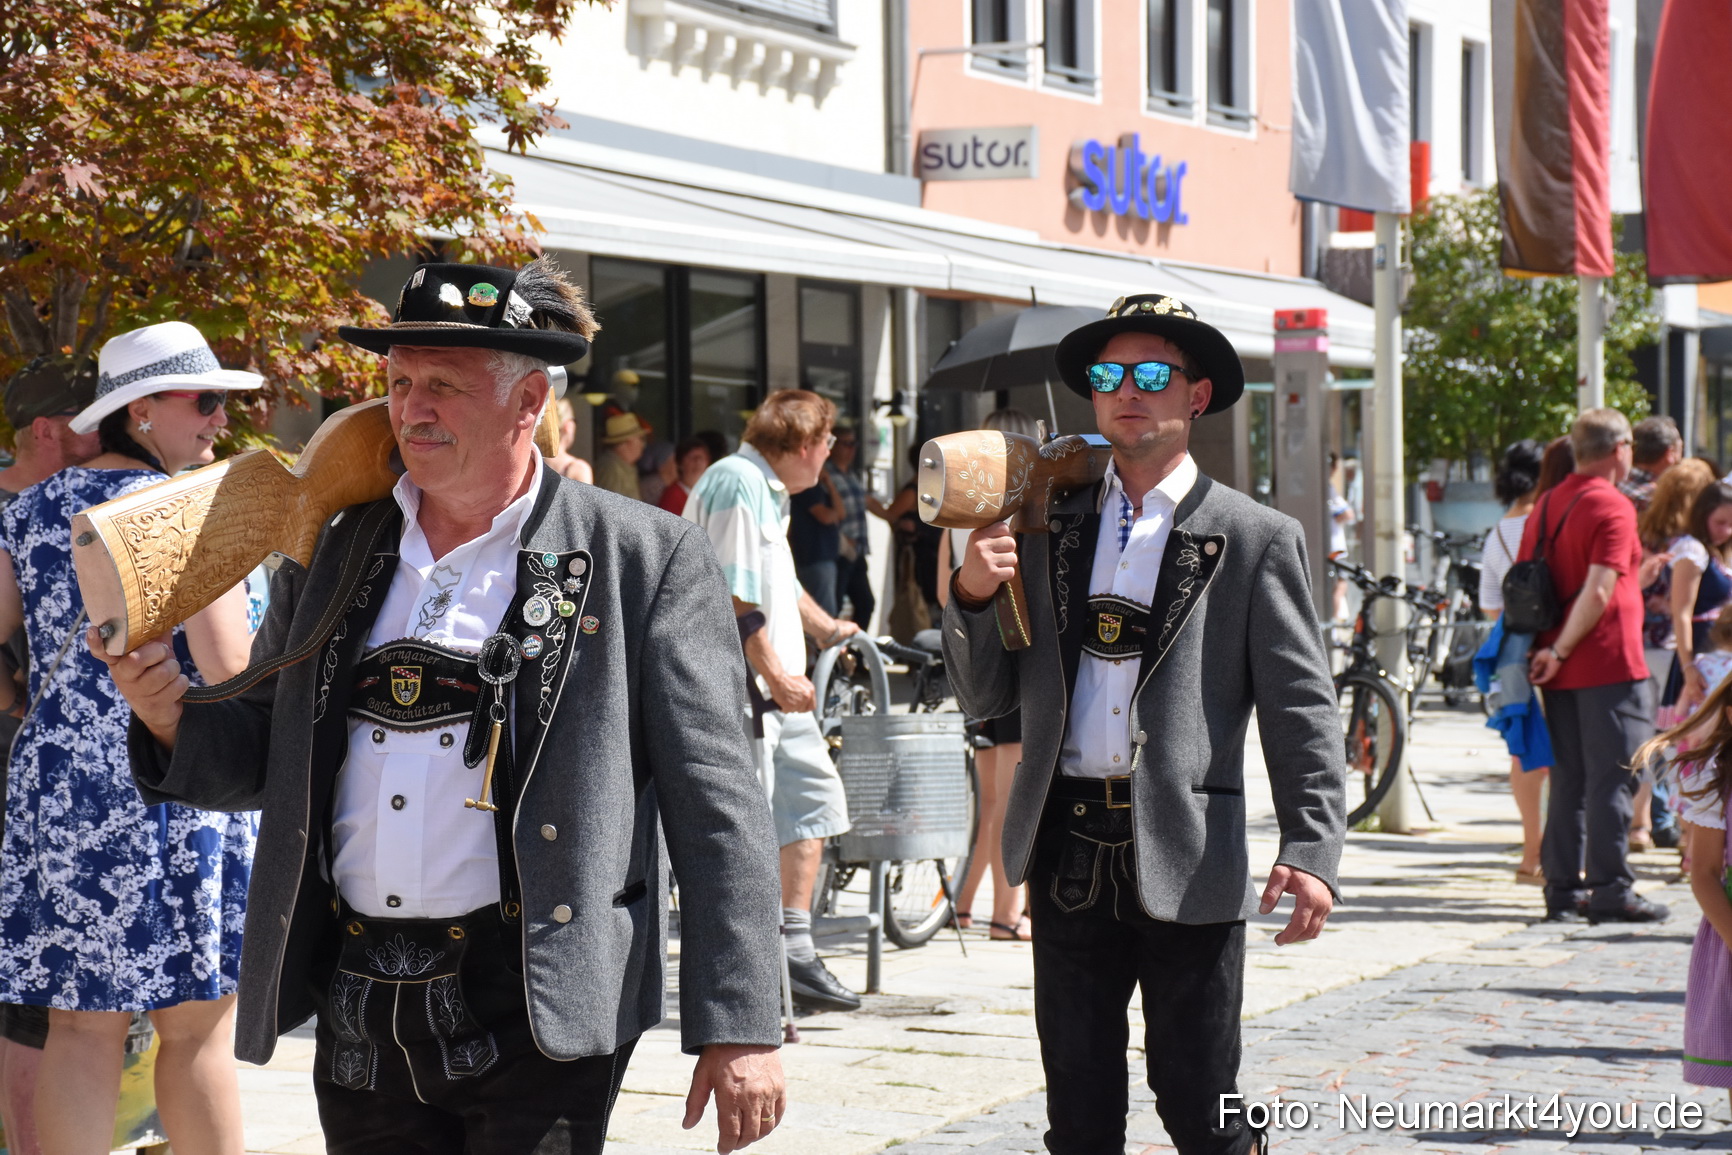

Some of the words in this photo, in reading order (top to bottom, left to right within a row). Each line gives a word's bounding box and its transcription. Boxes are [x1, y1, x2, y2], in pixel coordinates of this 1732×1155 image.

[921, 134, 1029, 171] sutor.
[1089, 601, 1136, 617] Berngauer
[378, 649, 441, 665] Berngauer
[366, 696, 452, 720] Böllerschützen
